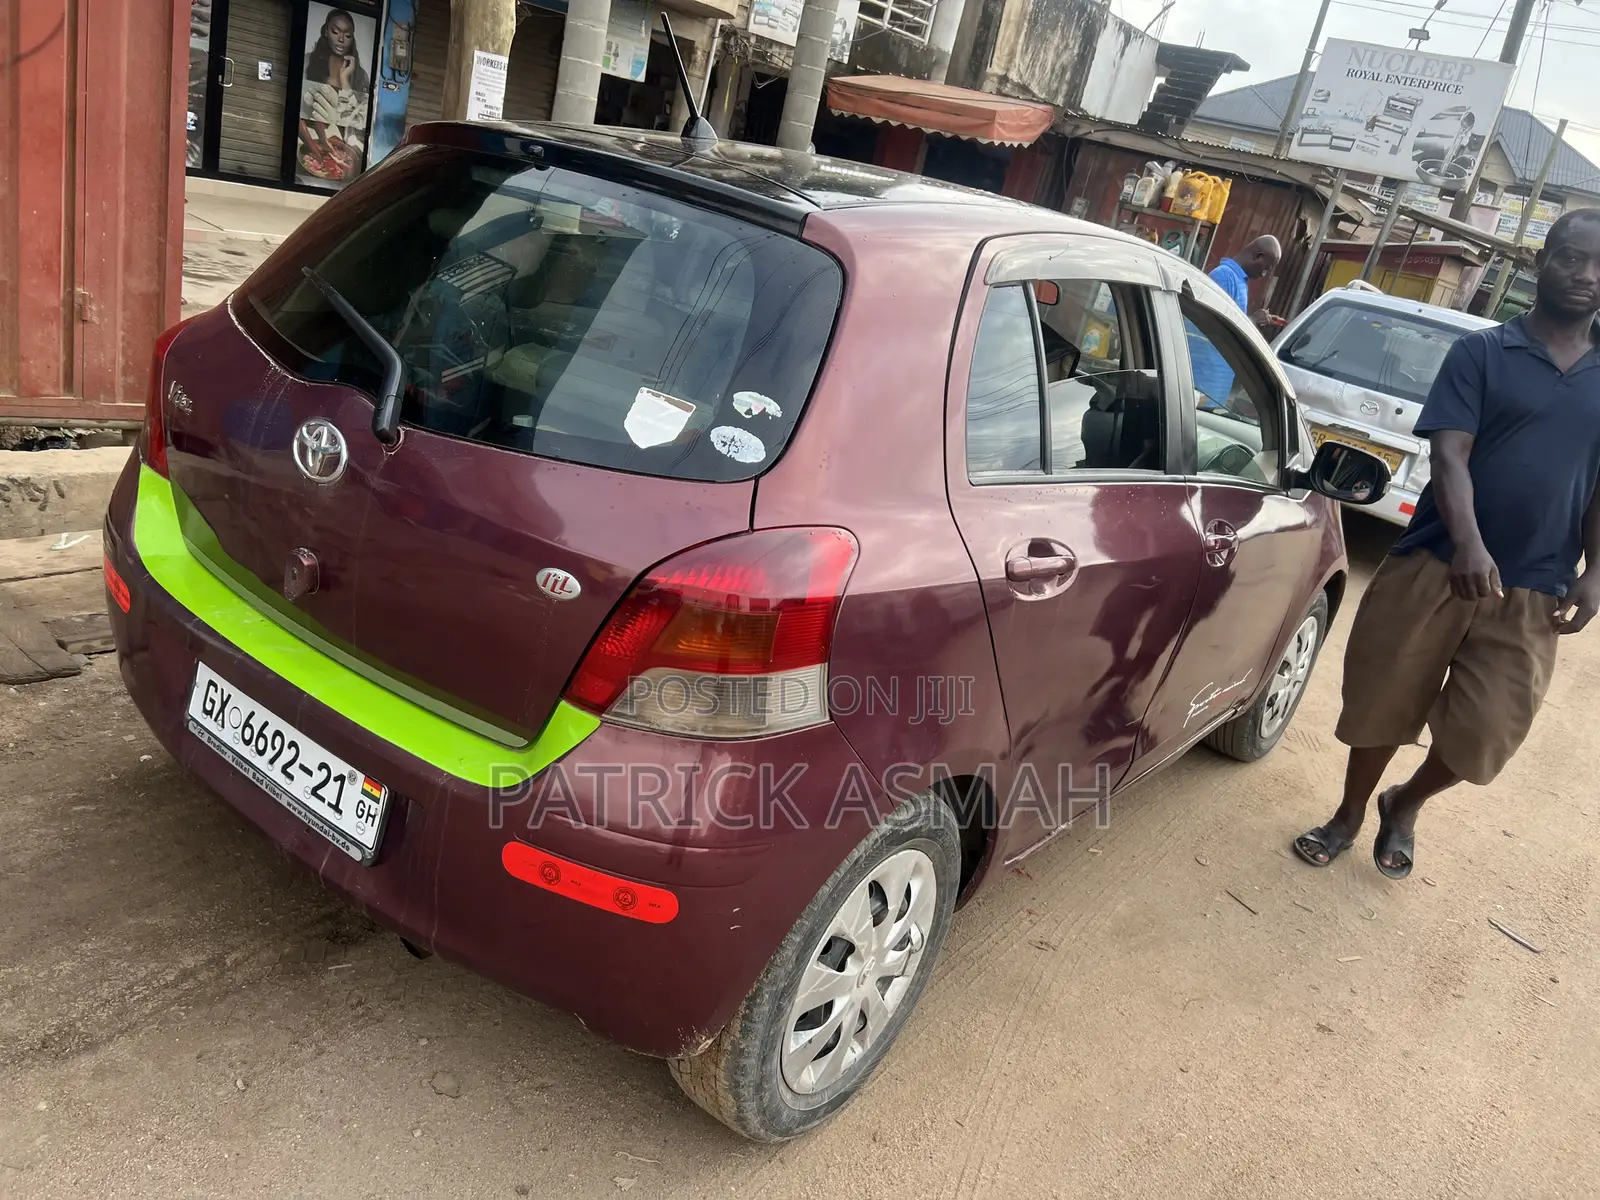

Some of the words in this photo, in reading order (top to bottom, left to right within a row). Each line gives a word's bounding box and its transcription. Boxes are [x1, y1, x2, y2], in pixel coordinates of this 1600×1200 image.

[476, 56, 503, 71] WORKERS
[1346, 46, 1476, 83] NUCLEEP
[1346, 68, 1383, 83] ROYAL
[1385, 74, 1464, 95] ENTERPRICE
[202, 679, 232, 729] GX
[241, 711, 347, 816] 6692-21
[251, 772, 264, 787] Bad
[355, 799, 377, 827] GH
